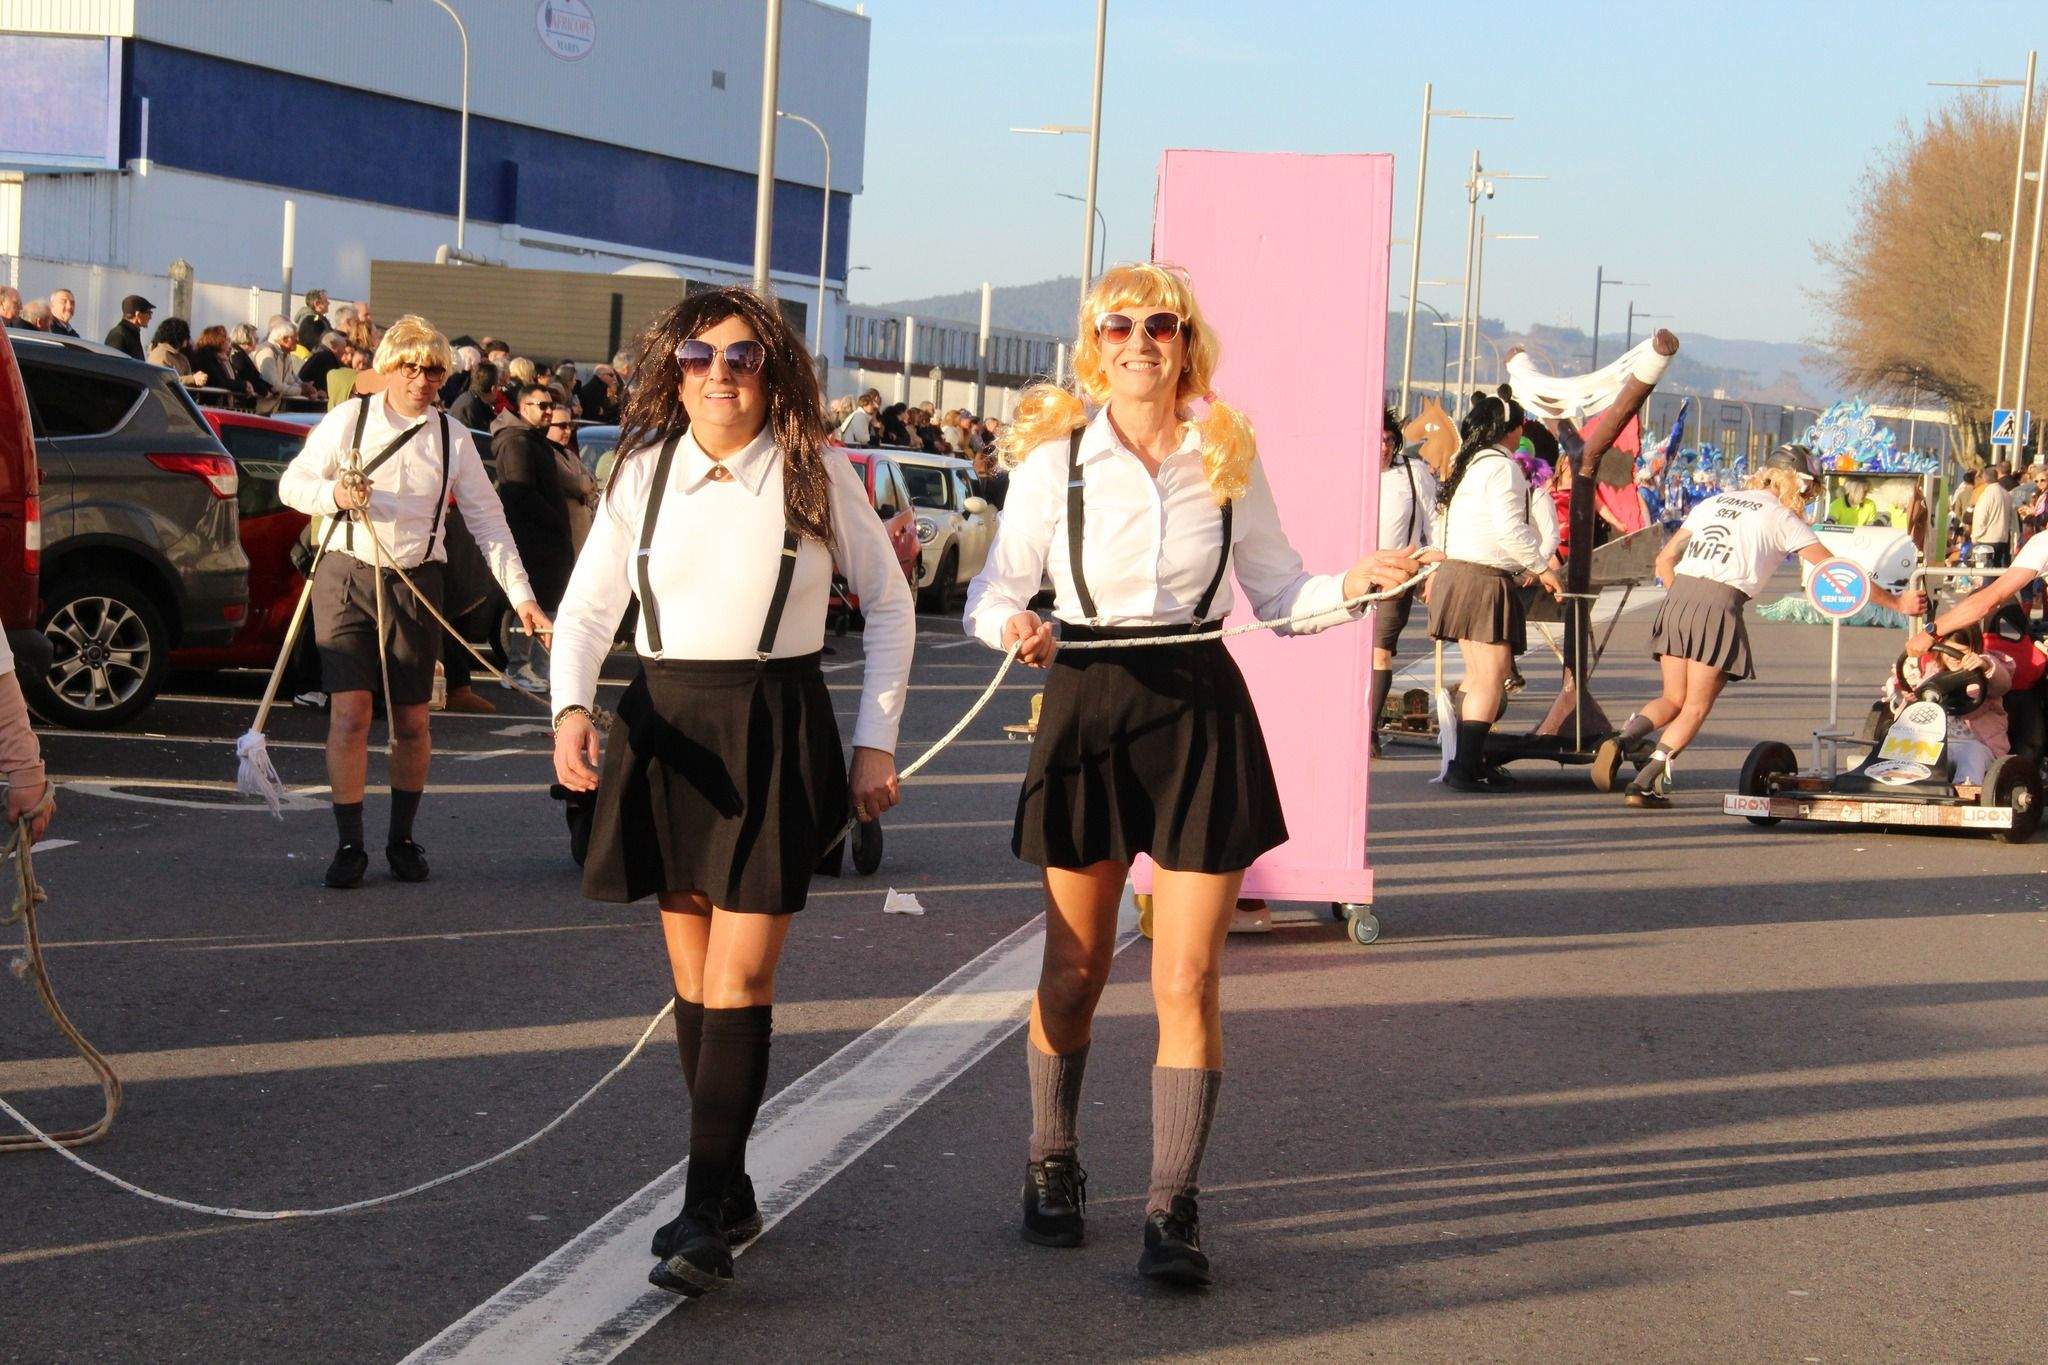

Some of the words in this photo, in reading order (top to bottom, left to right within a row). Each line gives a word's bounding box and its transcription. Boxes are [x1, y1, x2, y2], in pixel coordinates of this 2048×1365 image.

[1715, 495, 1764, 512] VAMOS
[1715, 507, 1743, 520] SEN
[1688, 540, 1734, 564] WiFi
[1820, 595, 1838, 603] SEN
[1725, 796, 1771, 812] LIRON
[1963, 808, 2012, 823] LIRON
